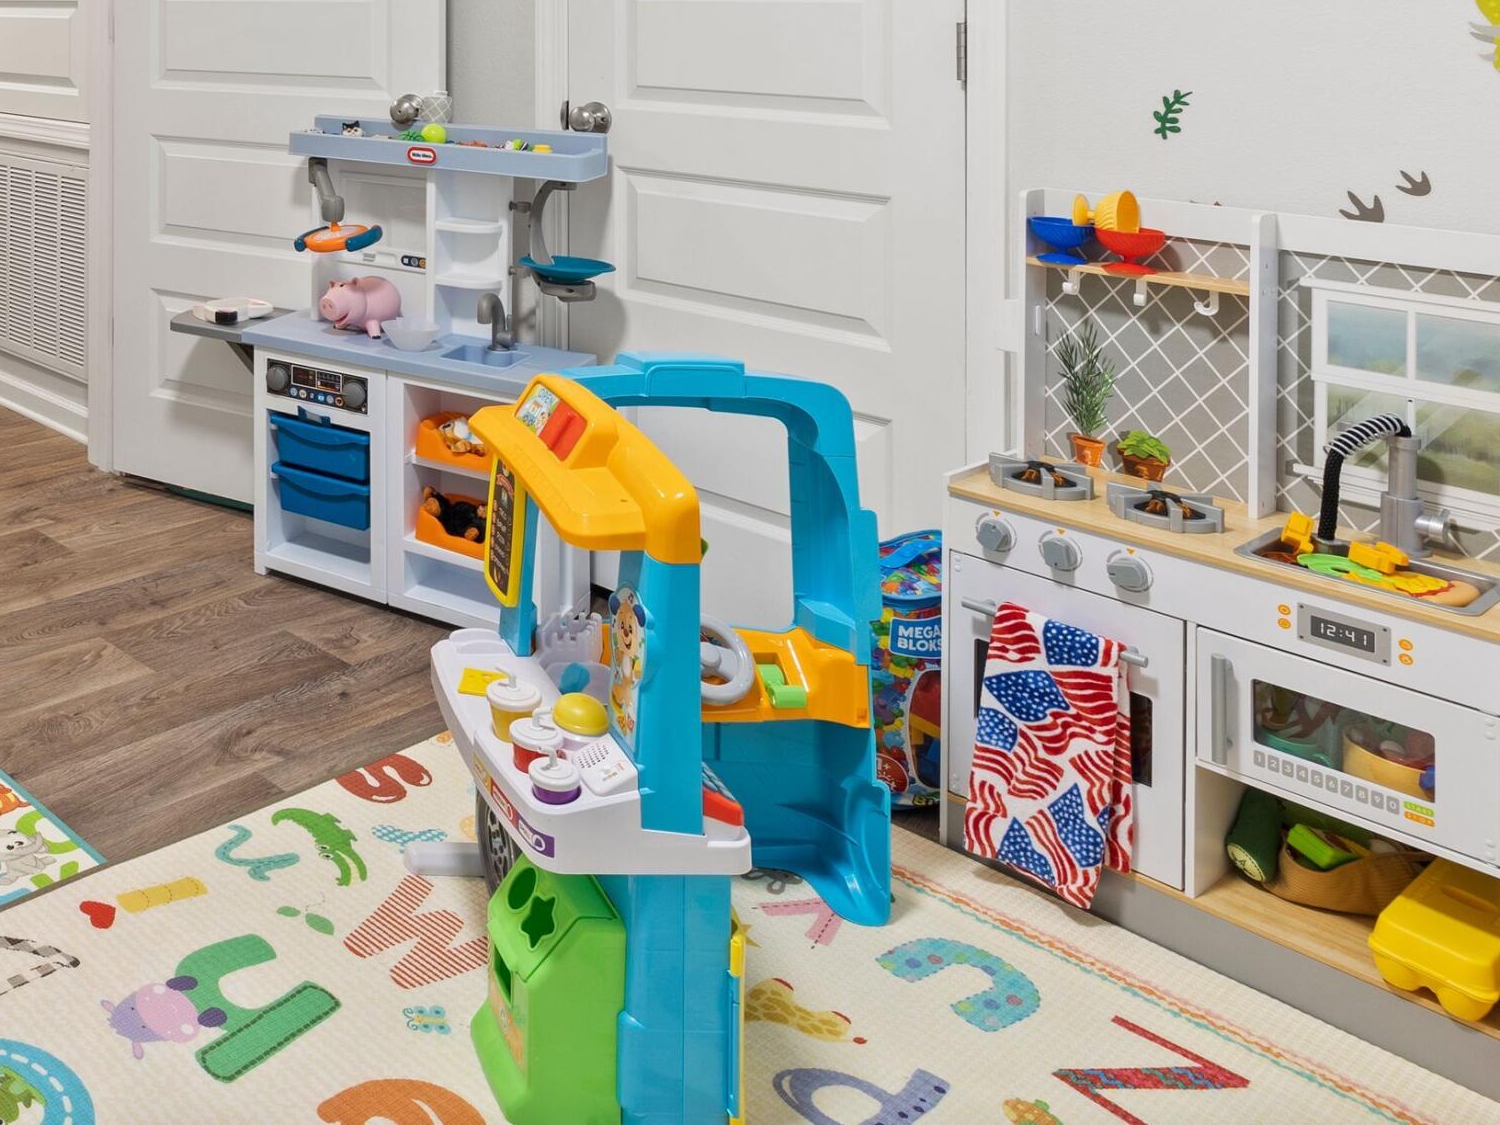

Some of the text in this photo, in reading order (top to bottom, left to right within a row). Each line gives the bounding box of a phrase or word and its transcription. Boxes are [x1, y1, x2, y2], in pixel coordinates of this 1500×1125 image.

[898, 624, 941, 639] MEGA
[1320, 622, 1367, 646] 12:41
[897, 637, 941, 652] BLOKS
